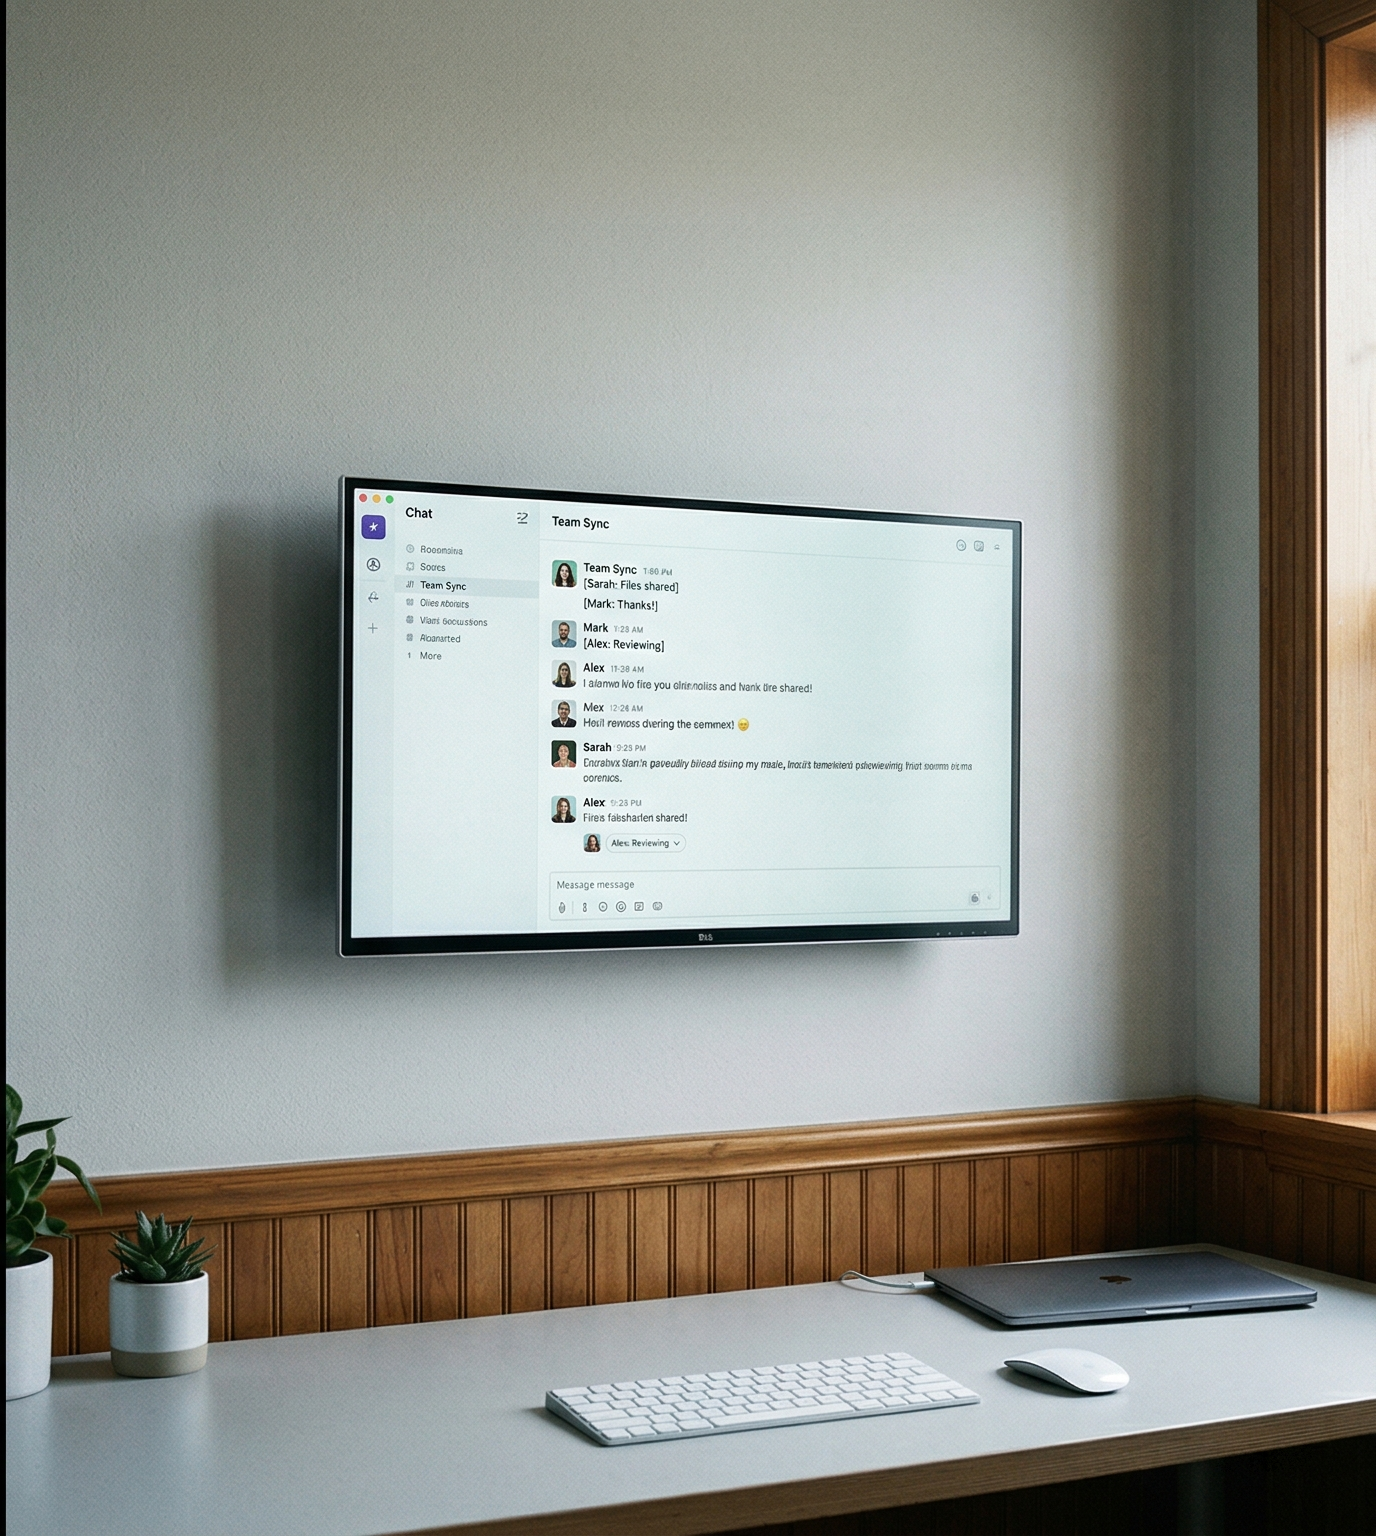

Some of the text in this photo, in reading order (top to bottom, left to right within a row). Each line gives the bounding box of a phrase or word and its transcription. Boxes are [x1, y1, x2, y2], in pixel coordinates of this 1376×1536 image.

[405, 507, 433, 519] Chat
[552, 516, 610, 530] Team Sync
[584, 563, 610, 573] Team
[613, 564, 637, 576] Sync
[420, 580, 467, 593] Team Sync
[584, 578, 679, 594] [Sarah: Files shared]
[584, 598, 658, 612] [Mark: Thanks!]
[584, 623, 609, 633] Mark
[584, 638, 665, 653] [Alex: Reviewing]
[420, 651, 442, 660] More
[583, 663, 605, 673] Alex
[632, 666, 644, 674] AM
[654, 681, 671, 691] you
[719, 682, 737, 692] and
[780, 683, 813, 693] shared!
[583, 702, 604, 712] Mex
[631, 705, 644, 713] AM
[677, 719, 692, 729] the
[583, 742, 612, 752] Sarah
[635, 744, 647, 752] PM
[745, 761, 759, 771] my
[583, 797, 606, 807] Alex
[655, 813, 688, 823] shared!
[631, 839, 670, 849] Reviewing
[596, 881, 635, 891] message
